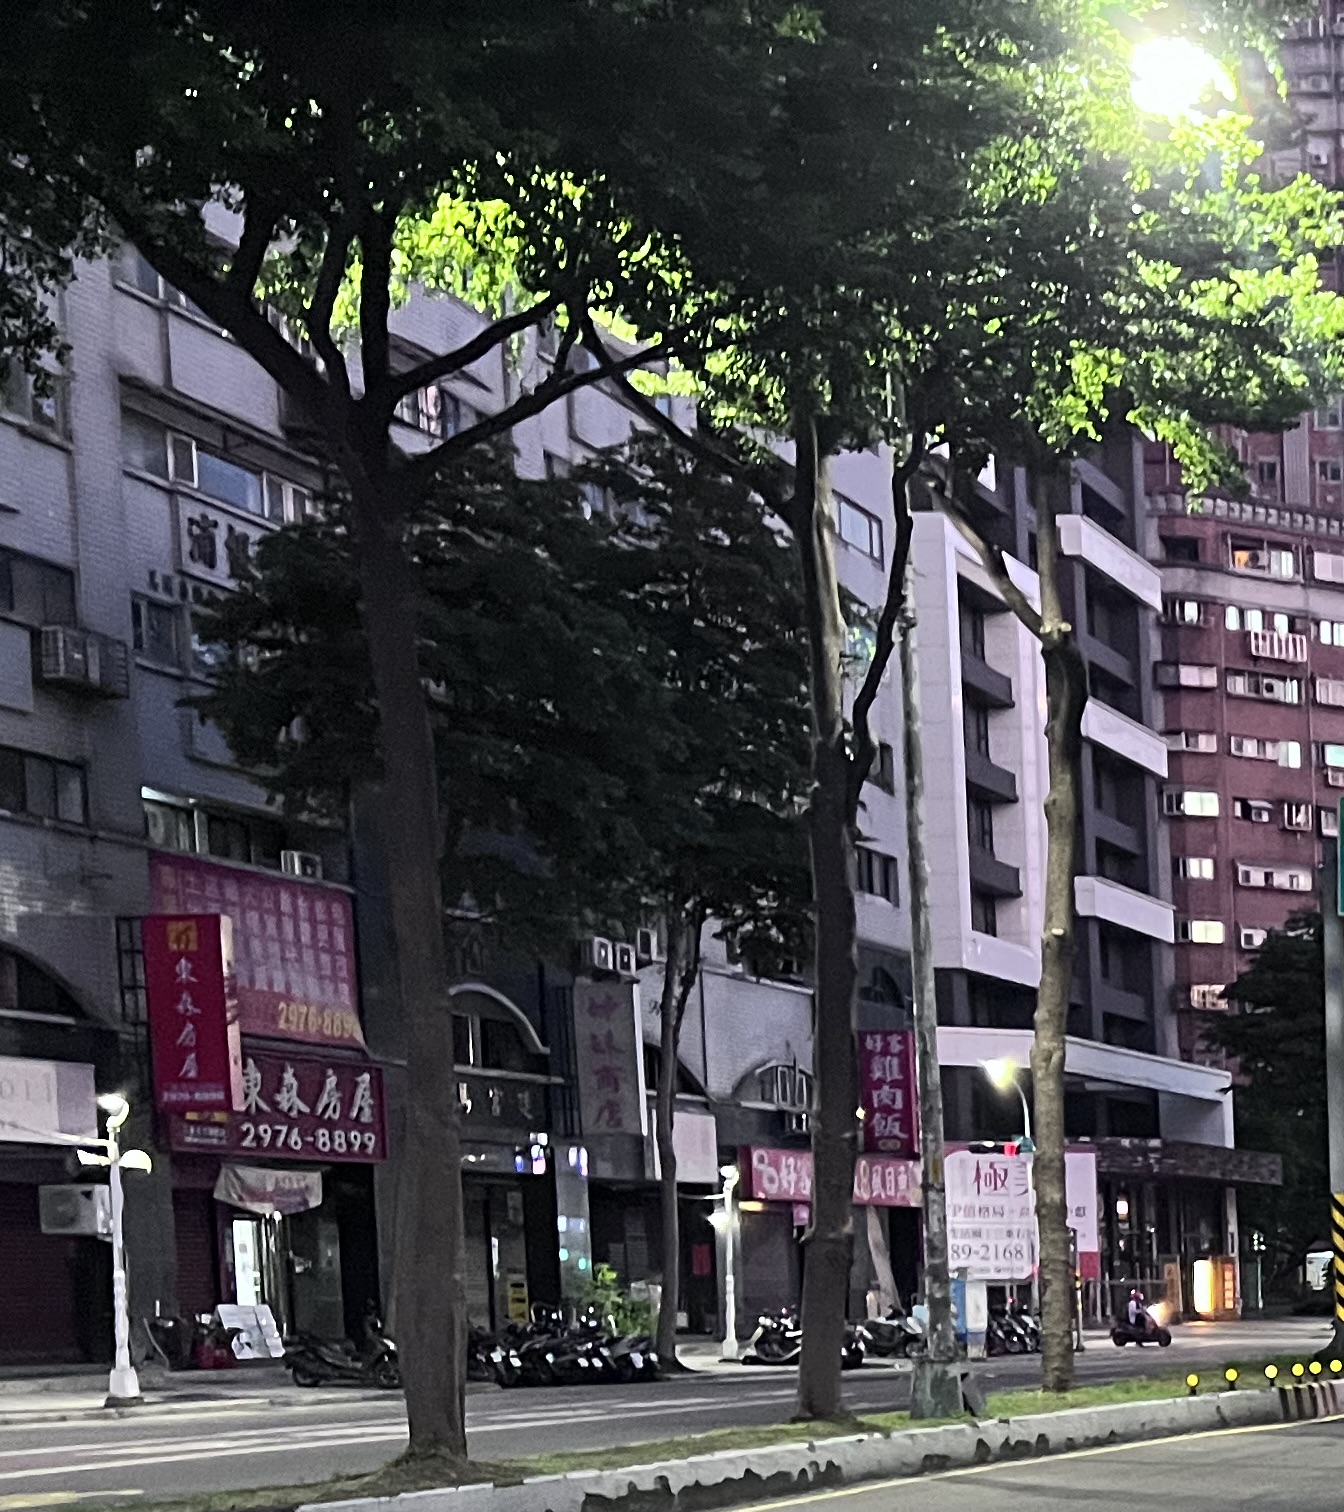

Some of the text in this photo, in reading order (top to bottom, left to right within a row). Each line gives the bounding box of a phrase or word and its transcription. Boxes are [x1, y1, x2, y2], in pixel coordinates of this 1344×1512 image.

[243, 1057, 374, 1123] 東森房屋
[240, 1122, 377, 1153] 2976-8899
